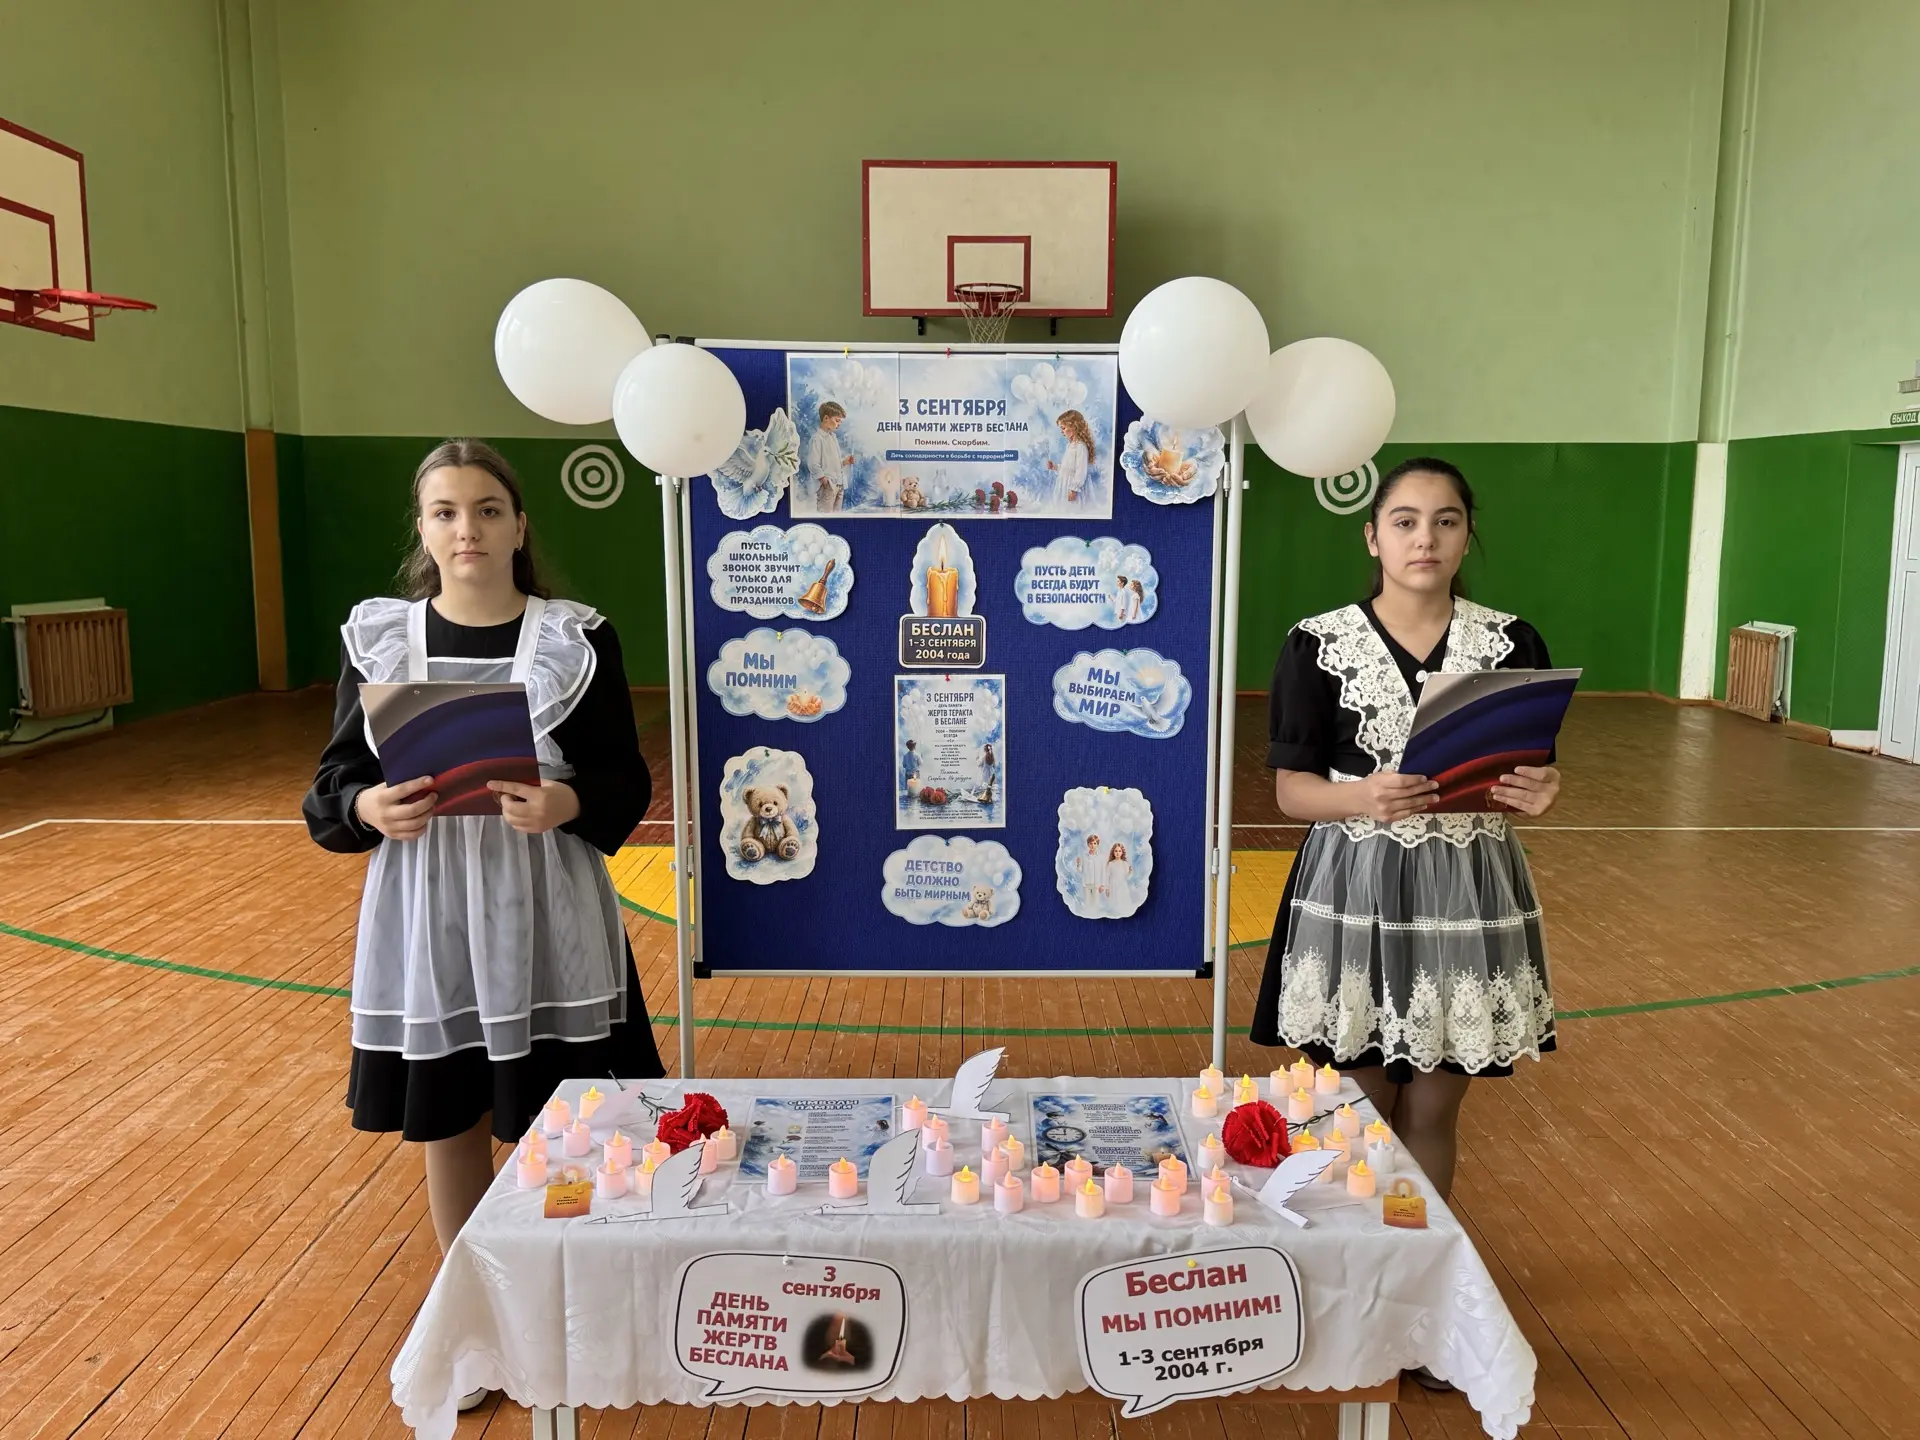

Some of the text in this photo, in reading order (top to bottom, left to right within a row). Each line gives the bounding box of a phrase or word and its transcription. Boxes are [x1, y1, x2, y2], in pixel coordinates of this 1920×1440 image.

[899, 399, 1006, 416] 3 СЕНТЯБРЯ
[1892, 412, 1917, 424] ВЫХОД
[877, 422, 902, 433] ДЕНЬ
[906, 422, 946, 432] ПАМЯТИ
[950, 422, 983, 432] ЖЕРТВ
[915, 438, 990, 447] Помним. Скорбим.
[951, 452, 971, 460] борьбе
[741, 542, 772, 551] ПУСТЬ
[729, 552, 789, 561] ШКОЛЬНЫЙ
[722, 564, 801, 572] ЗВОНОК ЗВУЧИТ
[1034, 565, 1096, 577] ПУСТЬ ДЕТИ
[728, 574, 792, 584] ТОЛЬКО ДЛЯ
[735, 586, 784, 594] УРОКОВ И
[1031, 580, 1100, 591] ВСЕГДА БУДУТ
[730, 596, 794, 605] ПРАЗДНИКОВ
[1027, 593, 1106, 604] В БЕЗОПАСНОСТИ
[911, 623, 974, 636] БЕСЛАН
[928, 638, 977, 648] СЕНТЯБРЯ
[915, 649, 970, 660] 2004 года
[743, 652, 775, 670] МЫ
[725, 671, 797, 689] ПОМНИМ
[1087, 667, 1121, 686] МЫ
[926, 692, 974, 703] 3 СЕНТЯБРЯ
[1068, 682, 1136, 703] ВЫБИРАЕМ
[927, 709, 974, 717] ЖЕРТВ ТЕРАКТА
[1078, 698, 1121, 718] МИР
[934, 717, 968, 726] В БЕСЛАНЕ
[904, 859, 963, 873] ДЕТСТВО
[906, 875, 960, 887] ДОЛЖНО
[894, 888, 970, 901] БЫТЬ МИРНЫМ
[823, 1266, 837, 1282] 3
[1125, 1263, 1248, 1298] Беслан
[782, 1281, 881, 1304] сентября
[710, 1291, 770, 1312] ДЕНЬ
[1101, 1294, 1283, 1334] МЫ ПОМНИМ!
[696, 1309, 789, 1334] ПАМЯТИ
[702, 1329, 778, 1351] ЖЕРТВ
[1118, 1337, 1265, 1367] 1-3 сентября
[689, 1346, 790, 1372] БЕСЛАНА
[1154, 1361, 1233, 1382] 2004 г.
